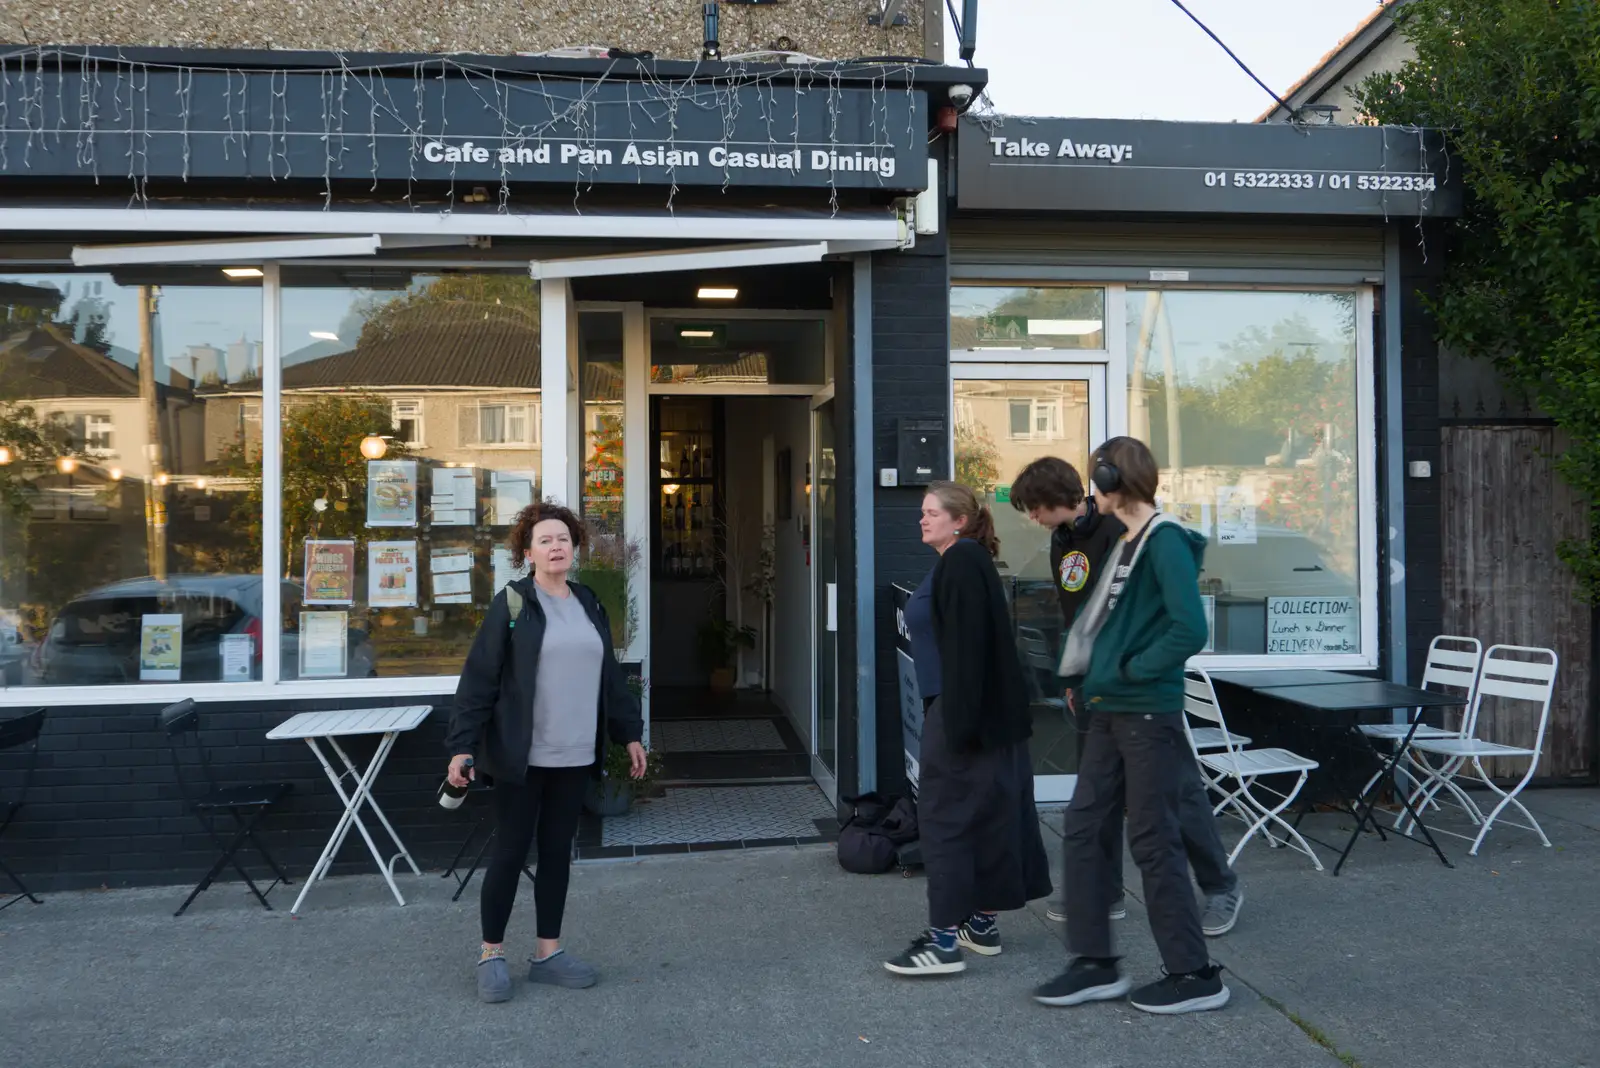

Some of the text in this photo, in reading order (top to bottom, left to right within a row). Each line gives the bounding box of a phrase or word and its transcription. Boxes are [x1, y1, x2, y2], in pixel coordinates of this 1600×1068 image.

[423, 142, 895, 178] Cafe and Pan Asian Casual Dining
[990, 137, 1133, 163] Take Away:
[1204, 171, 1437, 191] 01 5322333 / 01 5322334
[1272, 620, 1300, 634] Lunch
[1315, 620, 1347, 633] Dinner
